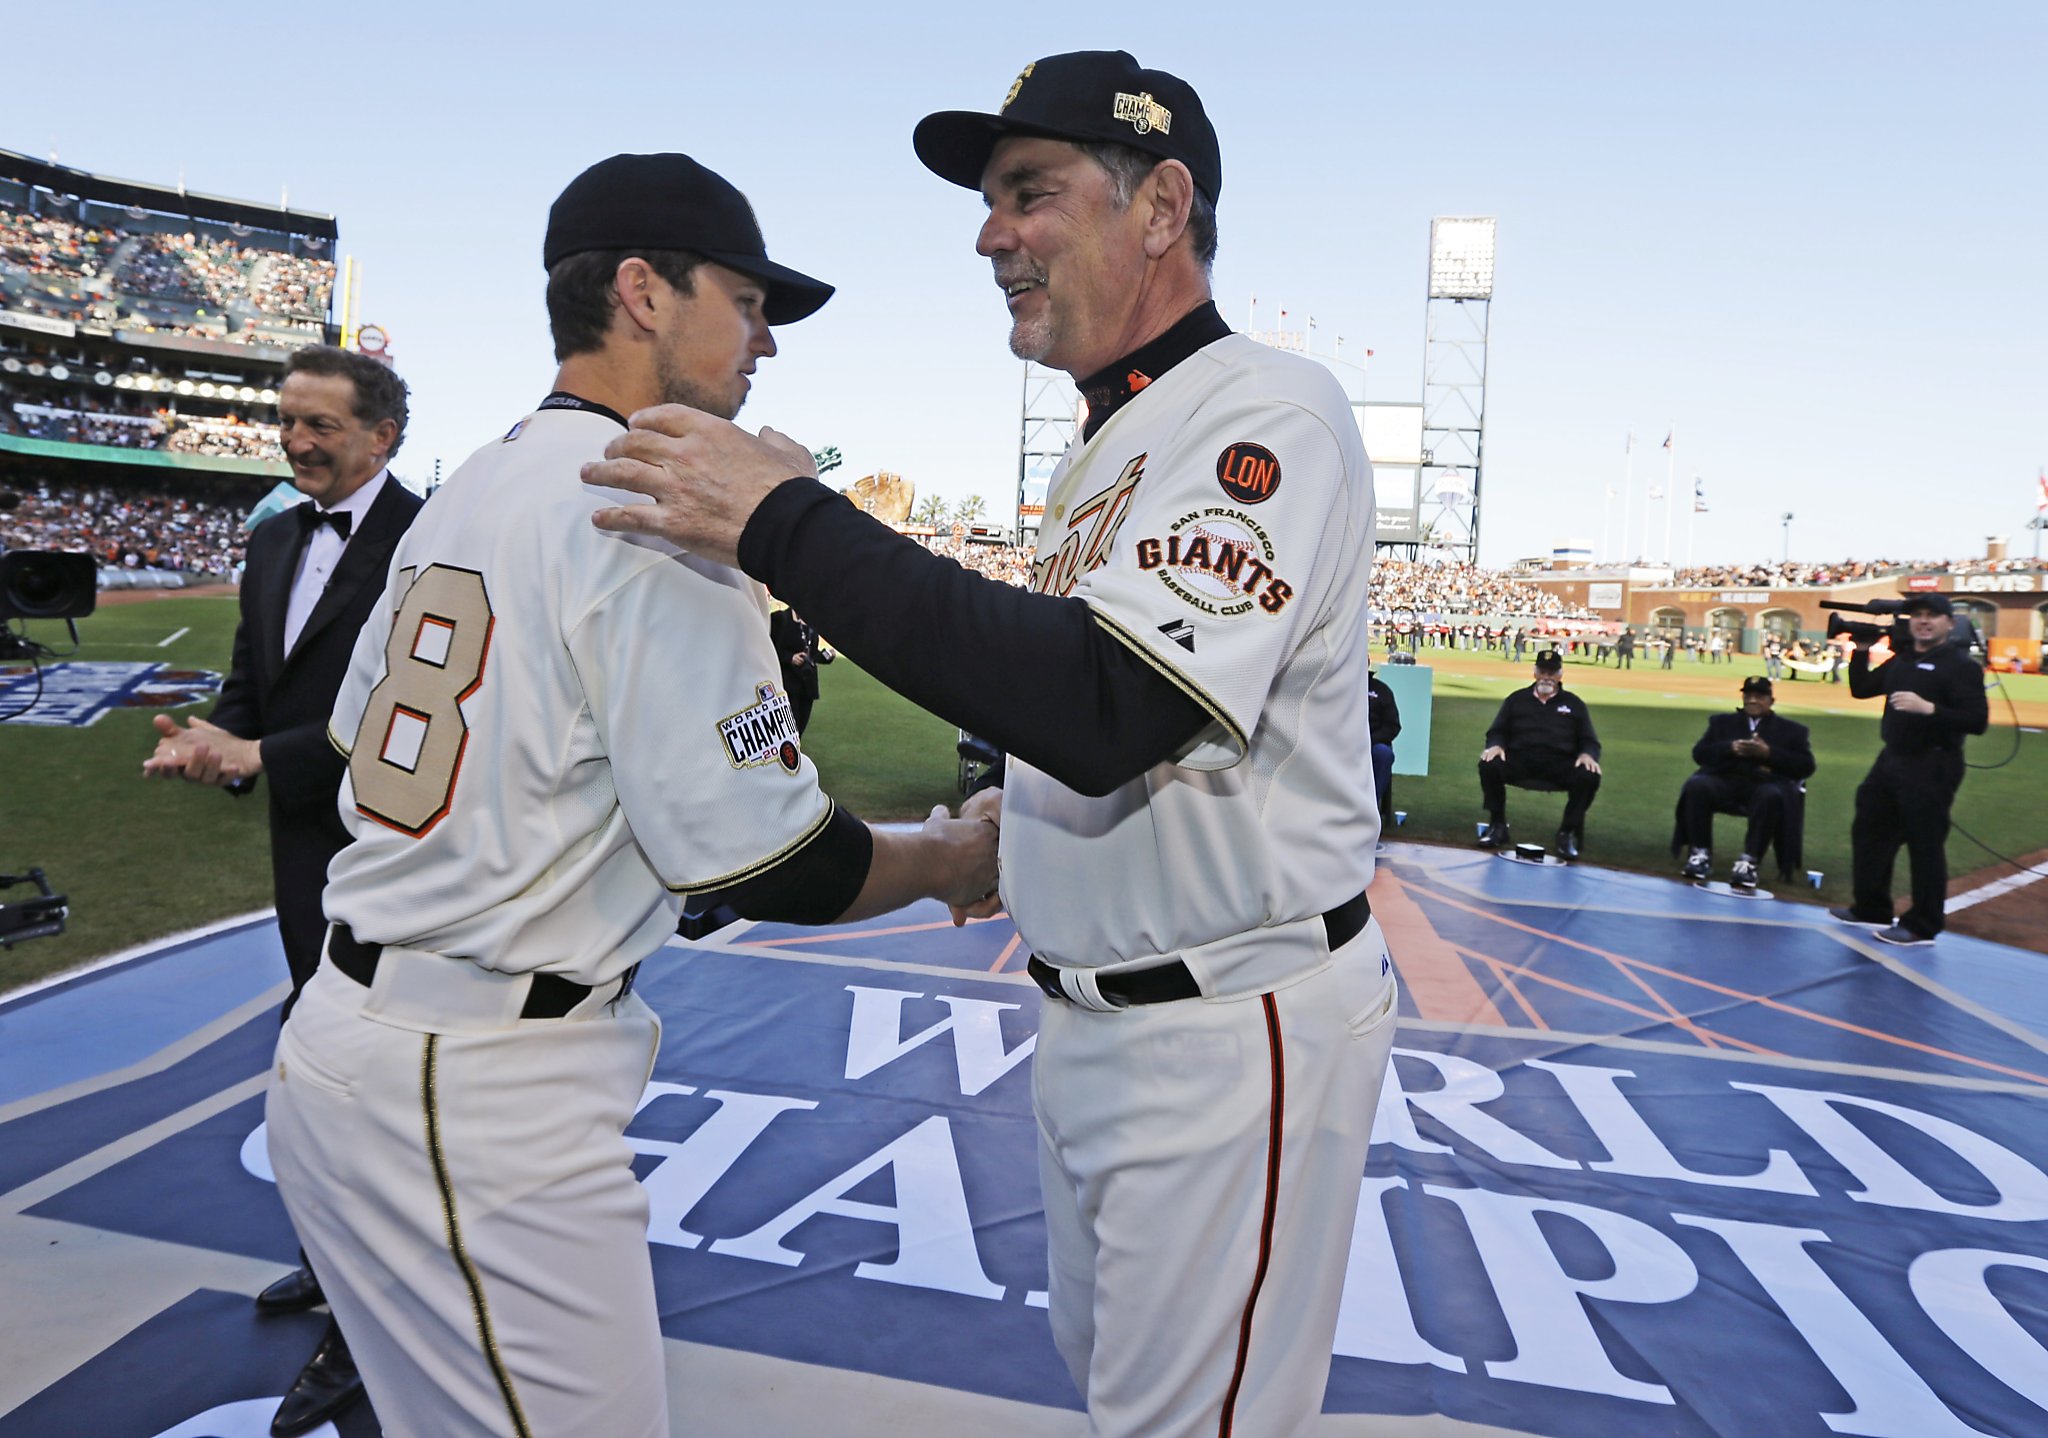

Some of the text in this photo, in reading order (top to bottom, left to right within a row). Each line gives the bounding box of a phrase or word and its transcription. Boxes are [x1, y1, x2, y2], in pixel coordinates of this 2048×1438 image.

[1223, 449, 1275, 495] LON
[1171, 507, 1275, 562] SAN FRANCISCO
[1136, 534, 1294, 615] GIANTS
[1157, 568, 1254, 616] BASEBALL CLUB
[721, 703, 769, 731] WORLD
[845, 984, 2048, 1223] WRLD
